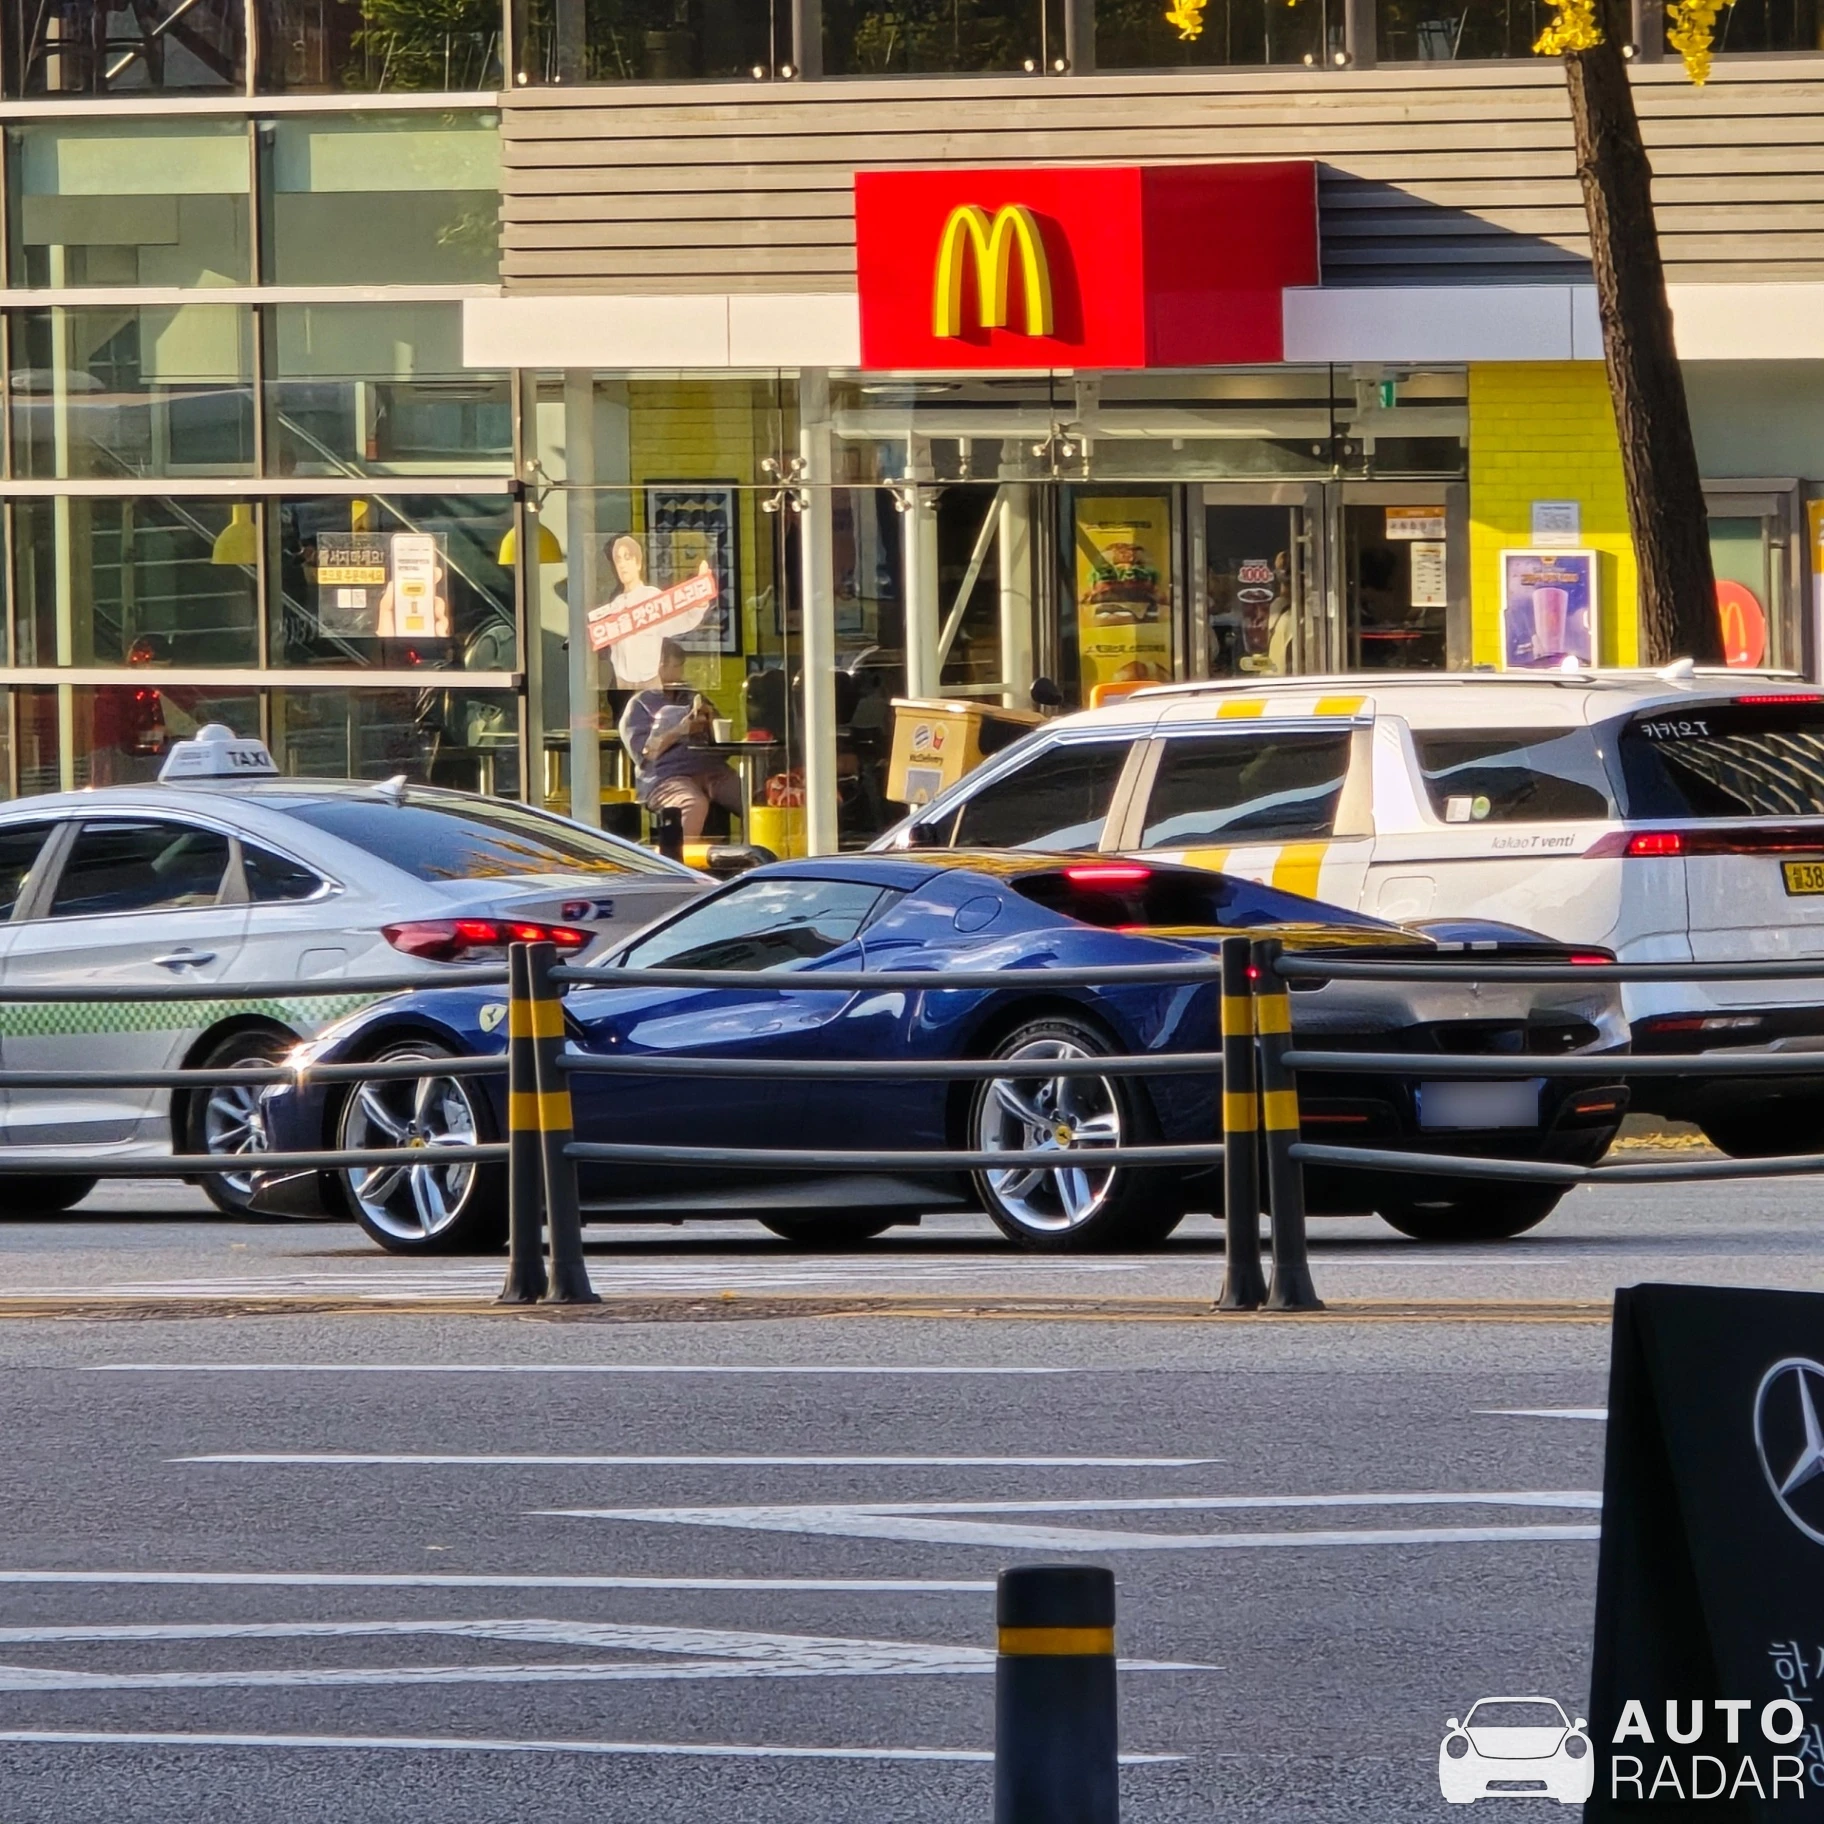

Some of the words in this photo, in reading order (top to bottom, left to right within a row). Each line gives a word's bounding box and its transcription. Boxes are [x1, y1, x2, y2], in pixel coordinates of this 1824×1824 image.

[1641, 721, 1709, 739] 카카오T
[226, 751, 271, 768] TAXI
[1491, 836, 1529, 849] kakao
[1530, 835, 1541, 848] T
[1540, 833, 1576, 848] venti
